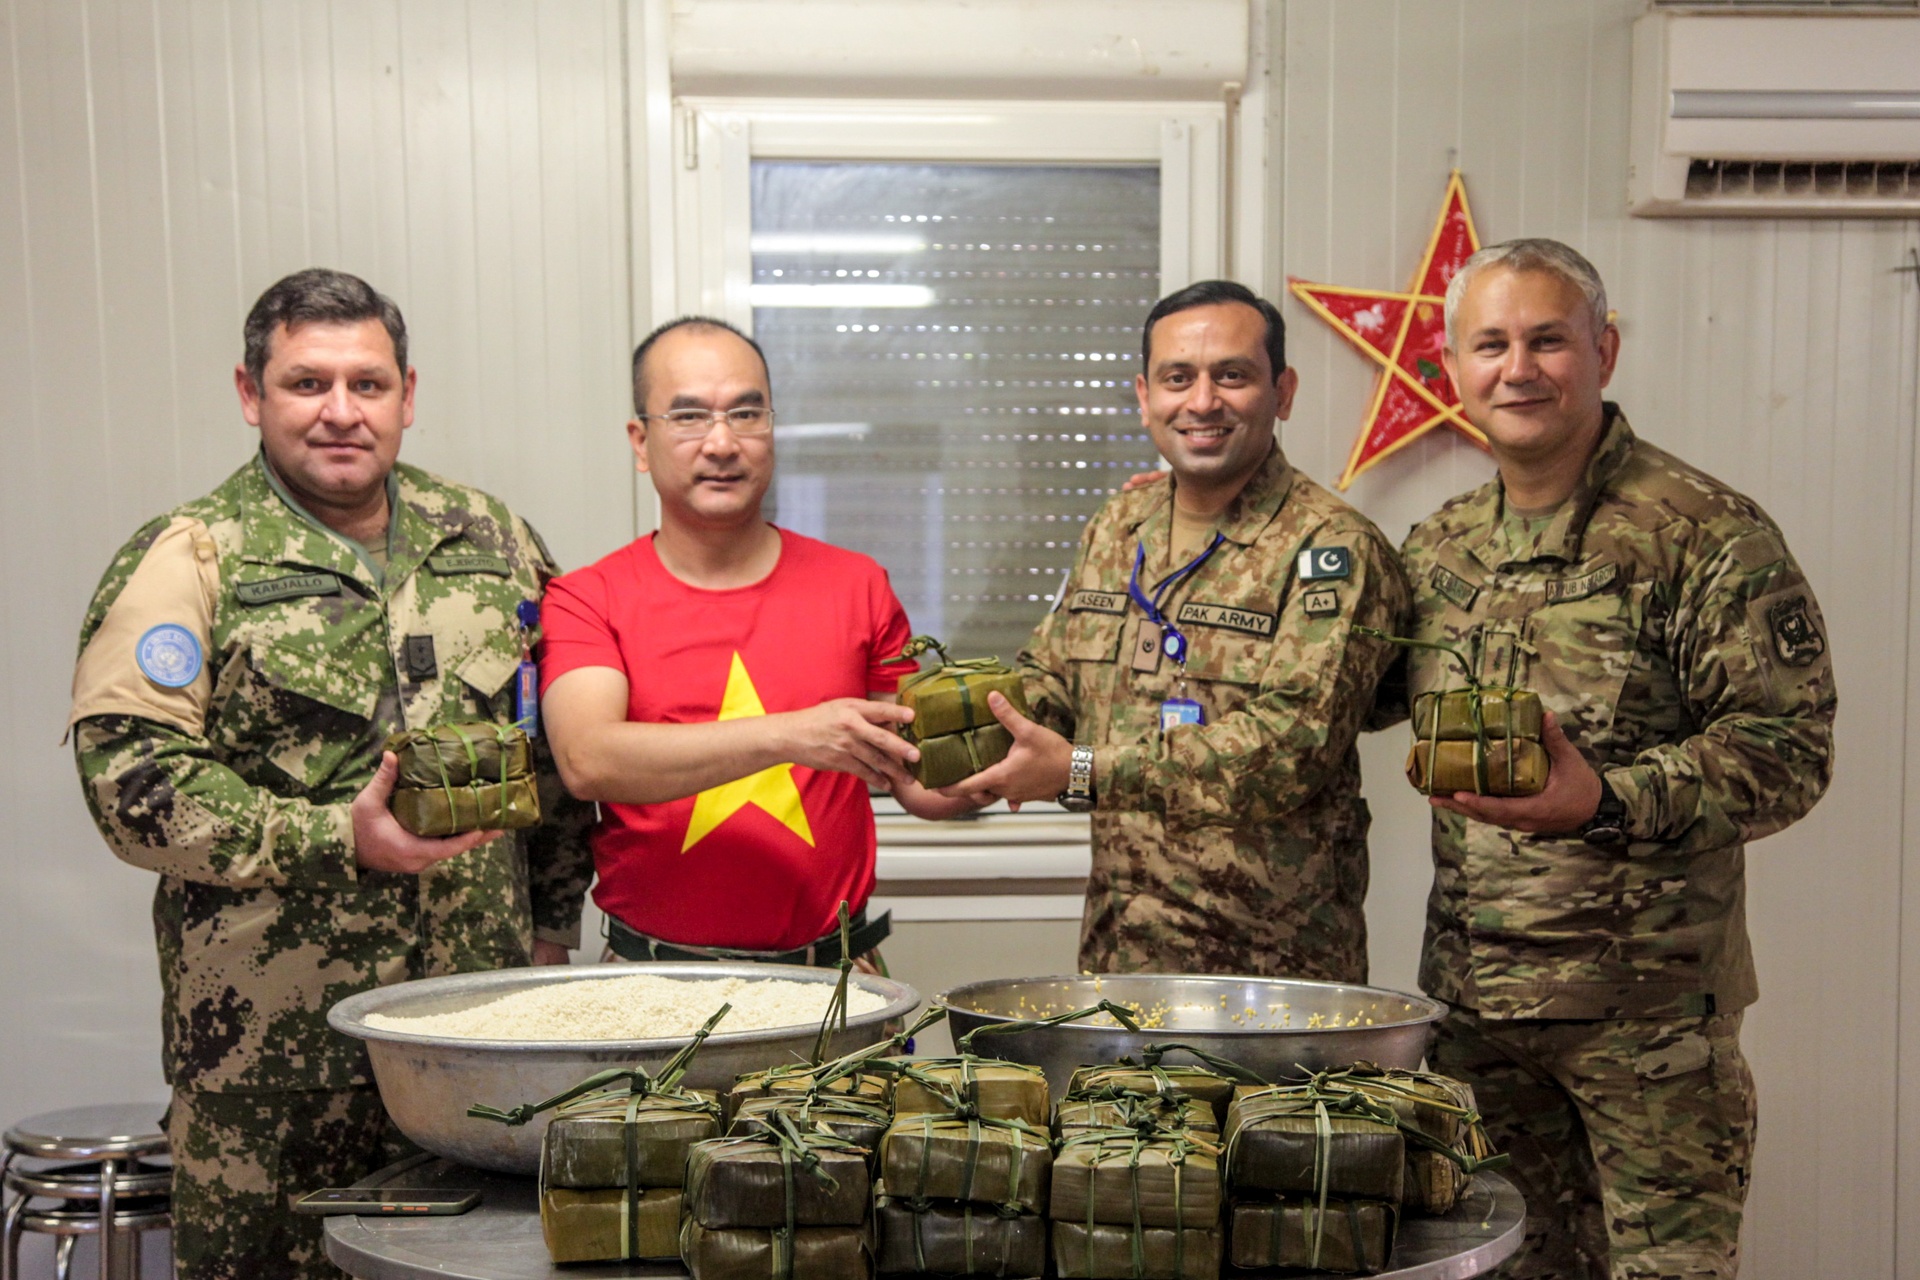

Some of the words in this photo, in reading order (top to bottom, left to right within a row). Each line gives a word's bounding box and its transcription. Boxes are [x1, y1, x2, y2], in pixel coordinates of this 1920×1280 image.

[1311, 596, 1329, 609] A+
[1183, 607, 1209, 620] PAK
[1217, 611, 1267, 630] ARMY
